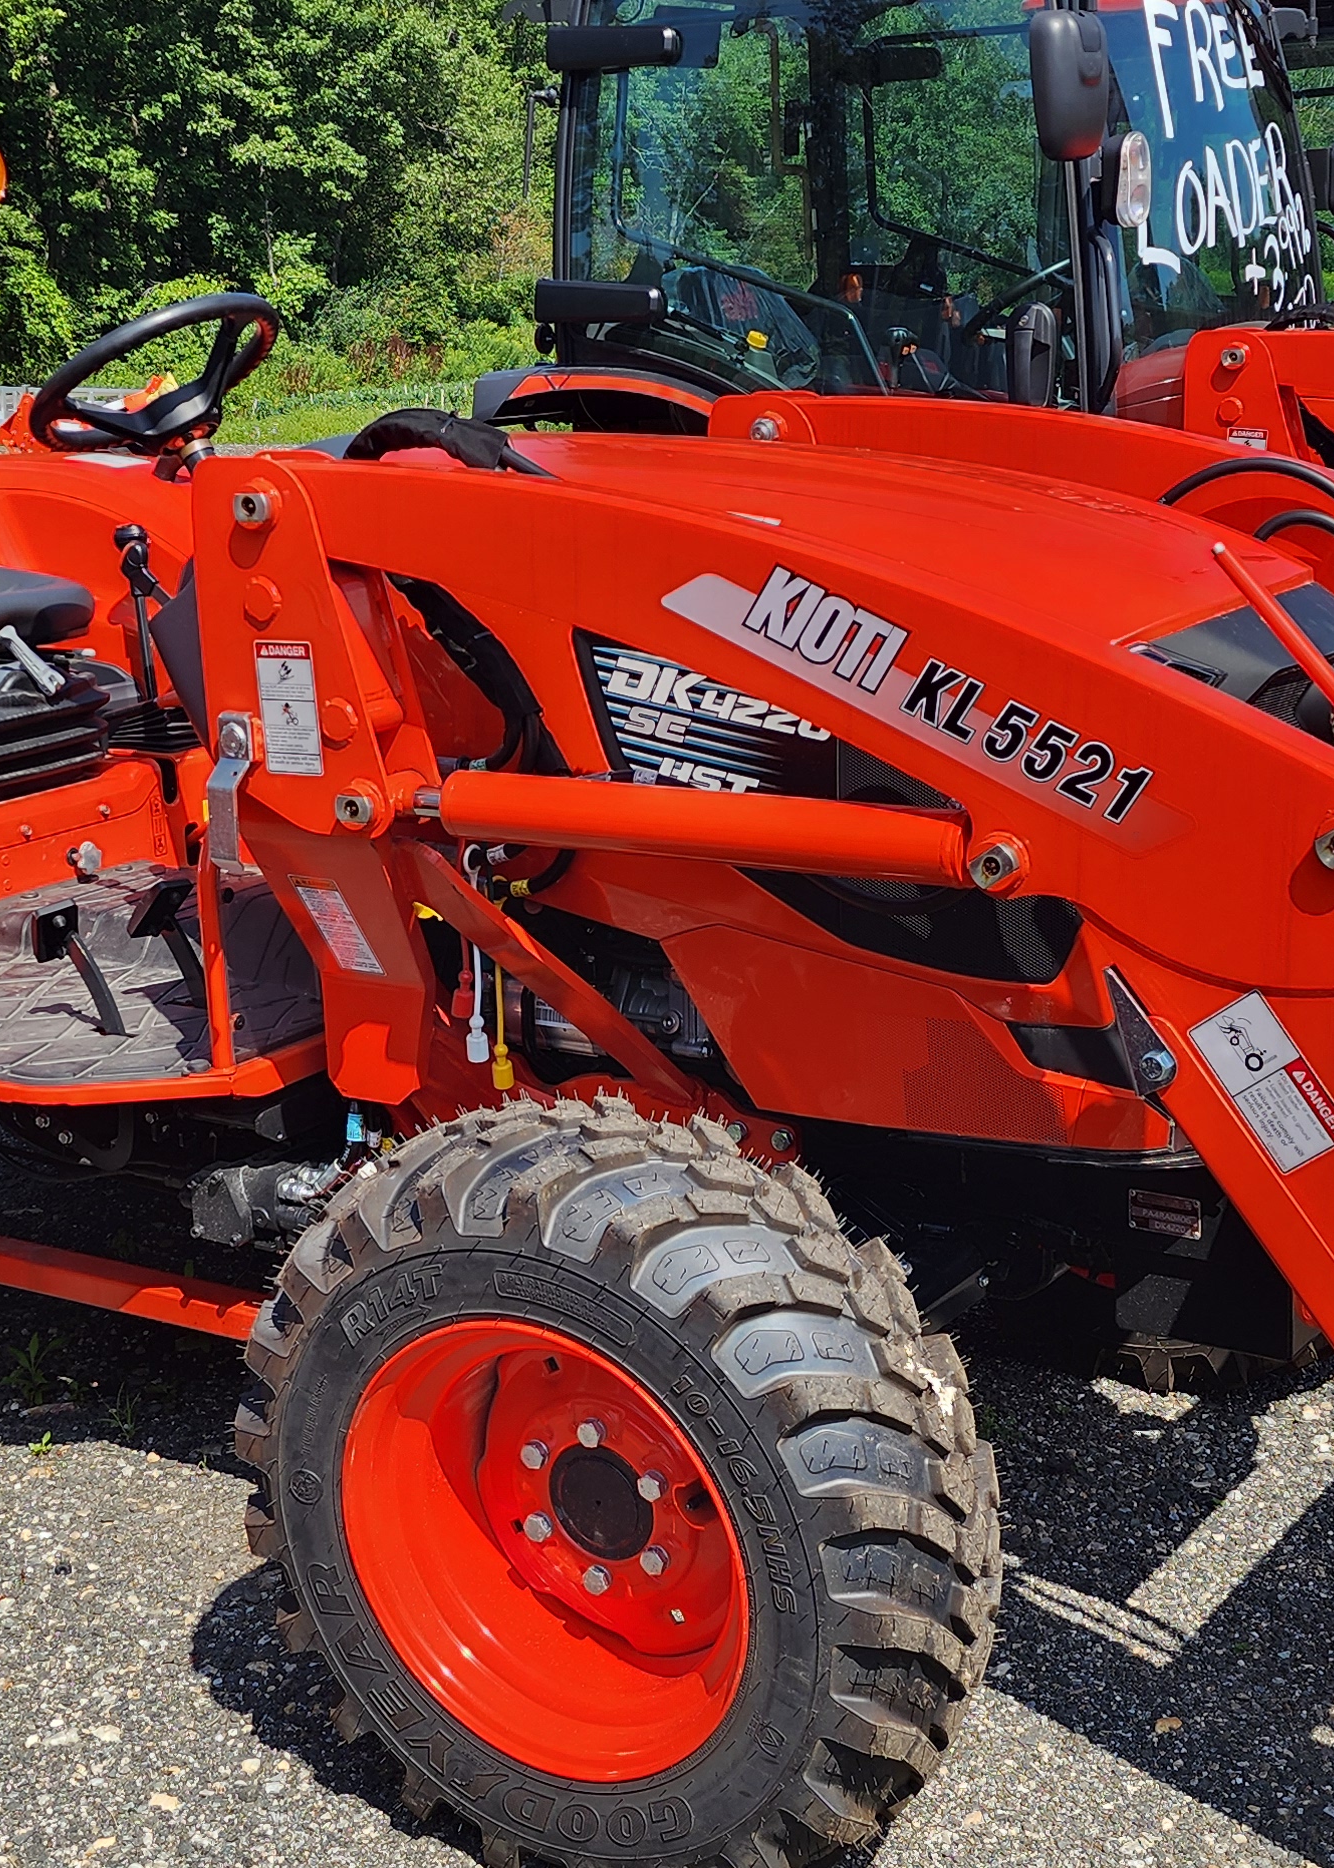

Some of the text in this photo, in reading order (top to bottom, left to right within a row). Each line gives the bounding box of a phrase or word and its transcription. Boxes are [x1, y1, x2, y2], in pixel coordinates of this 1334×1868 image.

[1144, 0, 1265, 138] FREE
[267, 645, 306, 657] DANGER
[742, 563, 913, 695] KIOTI
[624, 705, 692, 743] SE
[658, 756, 760, 794] HST
[339, 1264, 444, 1349] R14T
[307, 1562, 695, 1846] GOODYEAR
